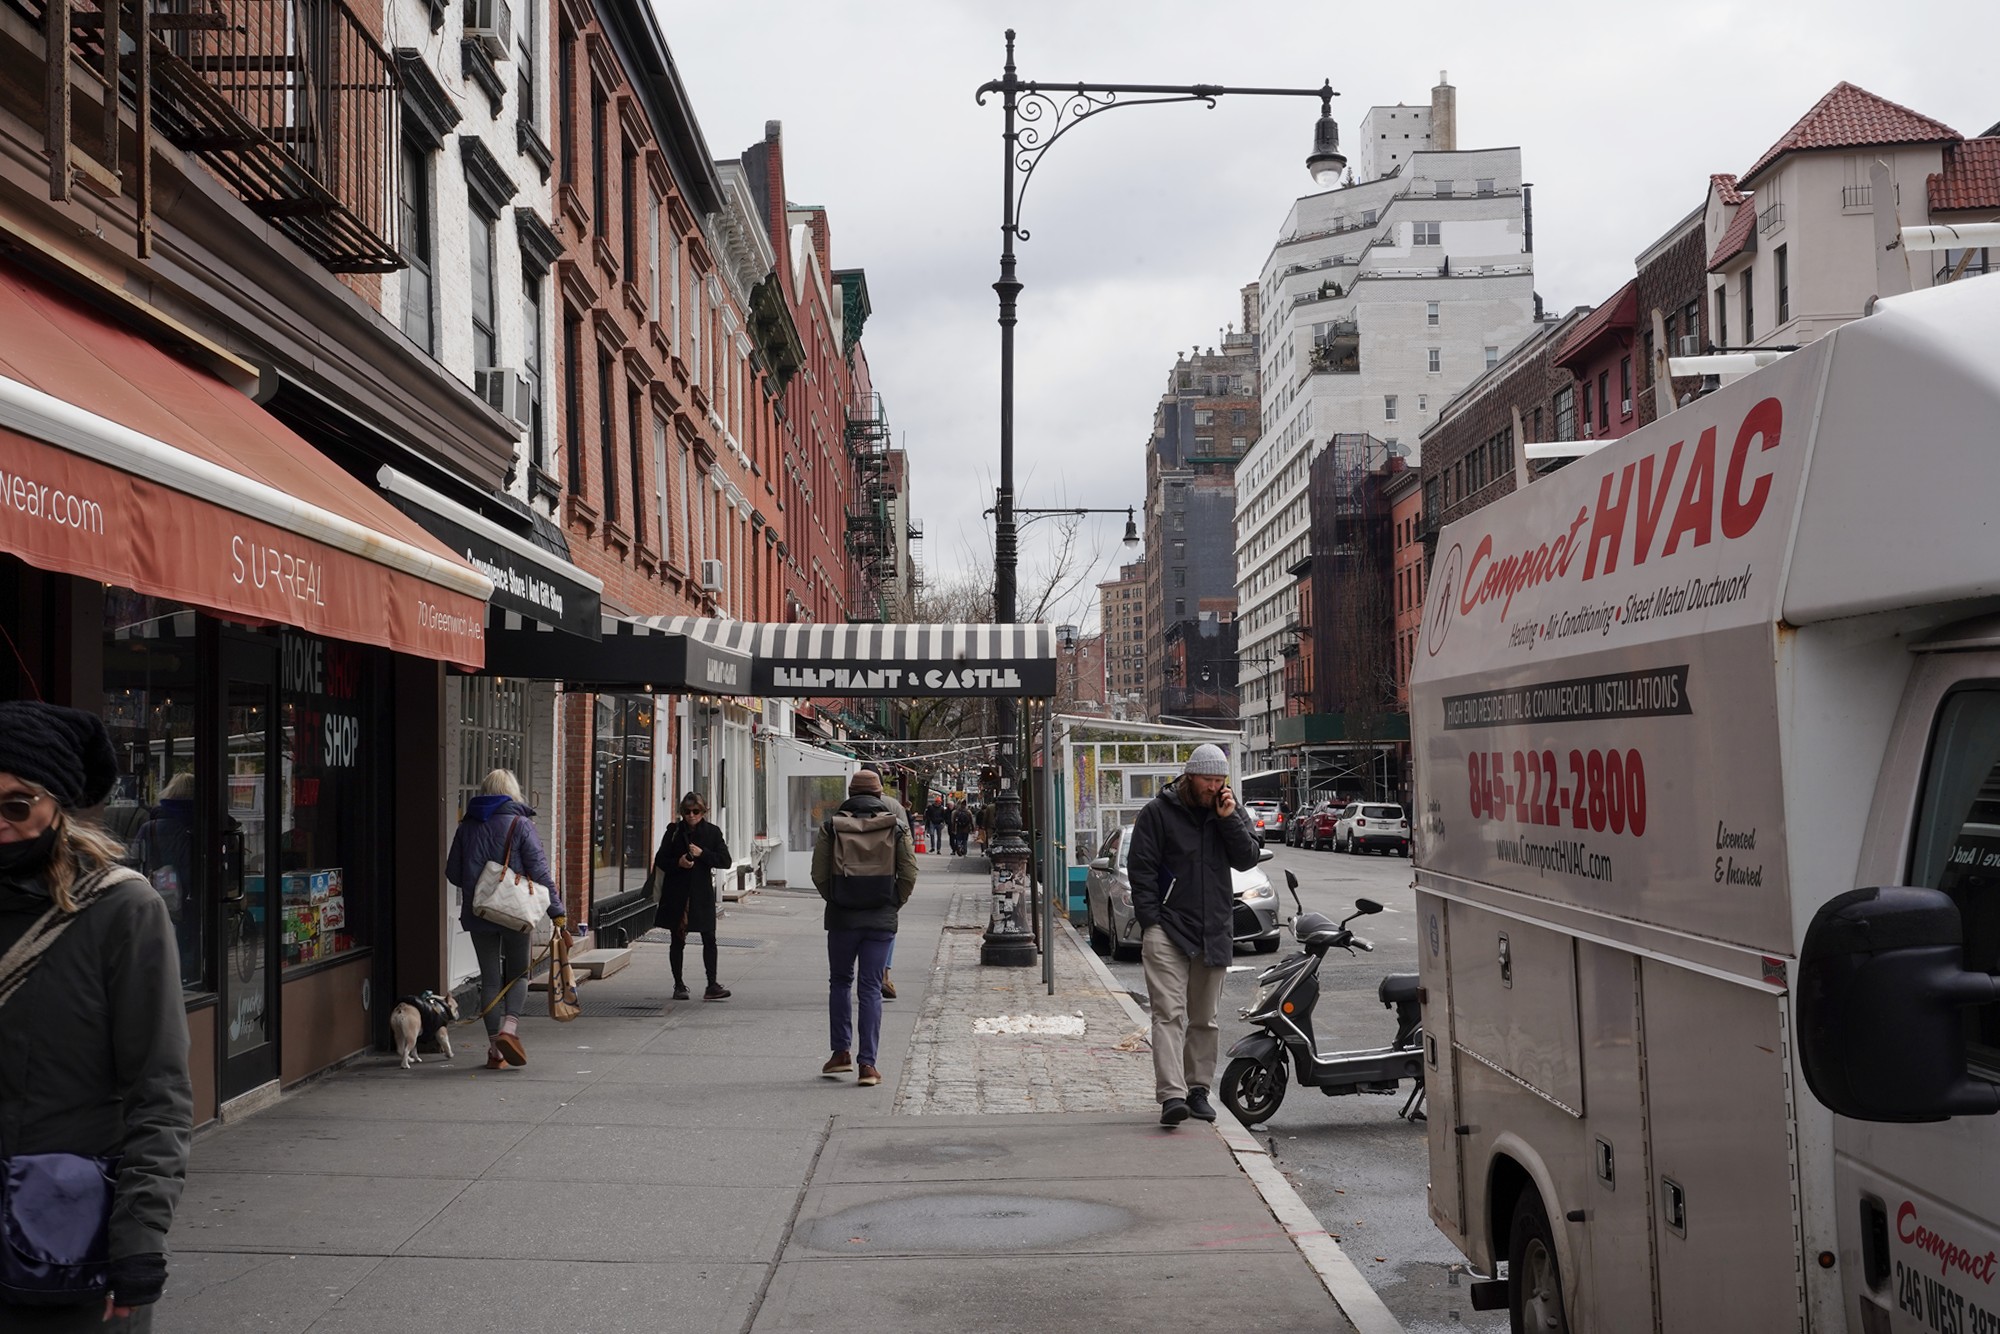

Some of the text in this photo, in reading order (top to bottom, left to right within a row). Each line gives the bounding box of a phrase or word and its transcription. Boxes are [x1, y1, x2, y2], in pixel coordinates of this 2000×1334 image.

[1460, 397, 1783, 623] Compact HVAC
[232, 535, 325, 606] SURREAL
[509, 566, 526, 599] Store
[529, 575, 540, 605] And
[540, 580, 551, 609] Gift
[550, 585, 562, 619] Shop
[418, 600, 483, 639] 70 Greenwich Ave.
[1508, 563, 1752, 650] Heating Air Conditioning Sheet Metal Ductwork
[773, 666, 1021, 689] ELEPHANT & CASTLE
[1447, 673, 1679, 724] HIGH END RESIDENTIAL & COMMERCIAL INSTALLATIONS
[323, 712, 359, 768] SHOP
[1468, 748, 1647, 838] 845-222-2800
[1496, 834, 1613, 882] www.CompactHVAC.com
[1716, 819, 1757, 850] Licensed
[1714, 855, 1763, 887] & Insured
[1896, 1200, 1998, 1285] Compact
[1897, 1260, 1923, 1322] 246
[1923, 1273, 1965, 1334] WEST
